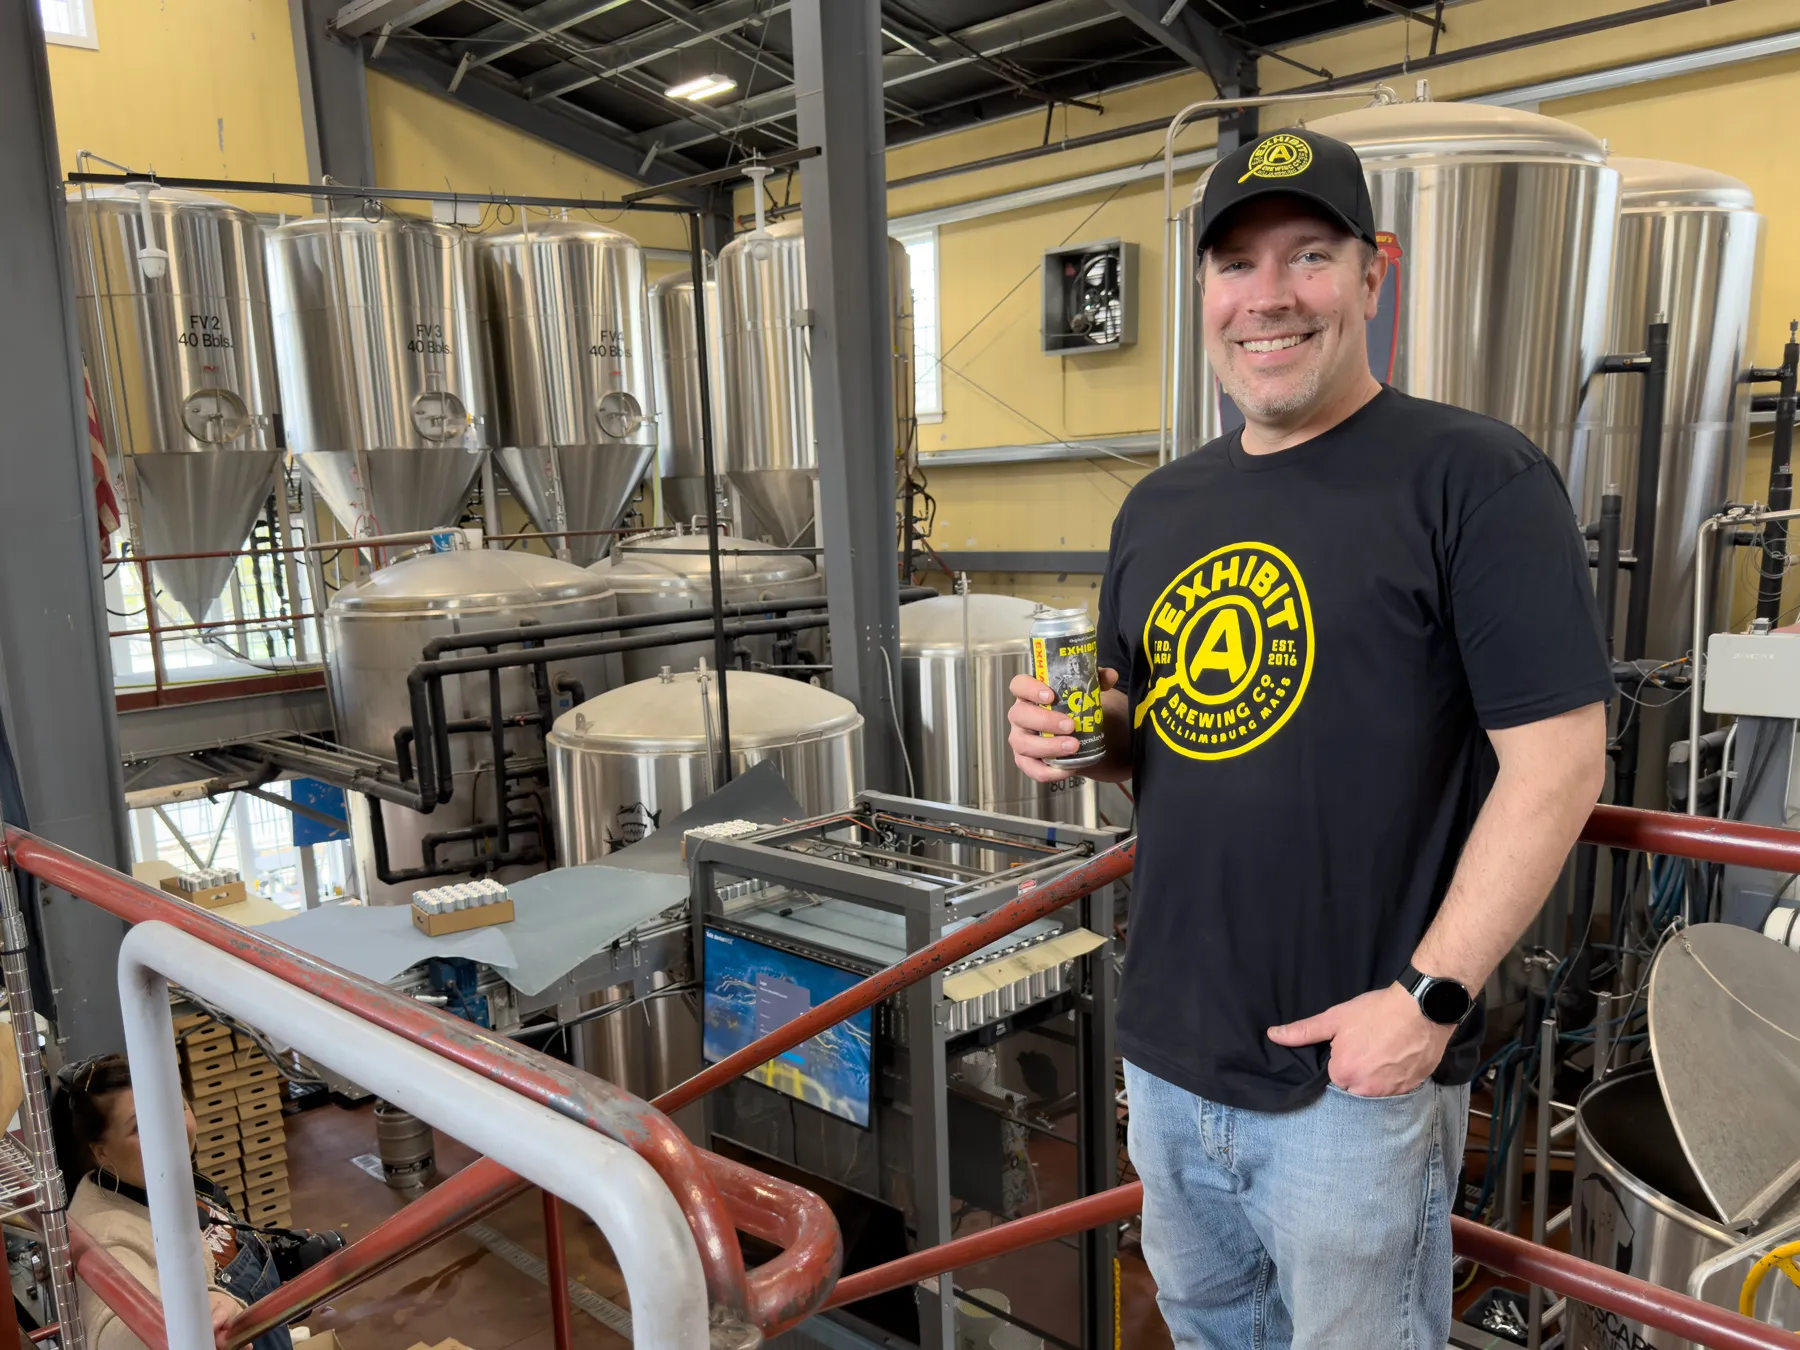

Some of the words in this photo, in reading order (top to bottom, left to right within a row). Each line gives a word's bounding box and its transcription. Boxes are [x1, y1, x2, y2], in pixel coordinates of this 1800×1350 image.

[1254, 136, 1309, 157] EXHIBIT
[1268, 145, 1292, 163] A
[178, 332, 199, 347] 40
[407, 340, 424, 353] 40
[589, 345, 606, 357] 40
[609, 345, 632, 358] Bbs.
[1154, 556, 1299, 635] EXHIBIT
[1189, 608, 1247, 683] A
[1272, 639, 1297, 652] EST.
[1268, 653, 1297, 666] 2016
[1160, 706, 1257, 744] WILLIAMSBURG
[1260, 677, 1291, 720] MASS
[1168, 693, 1250, 728] BREWING
